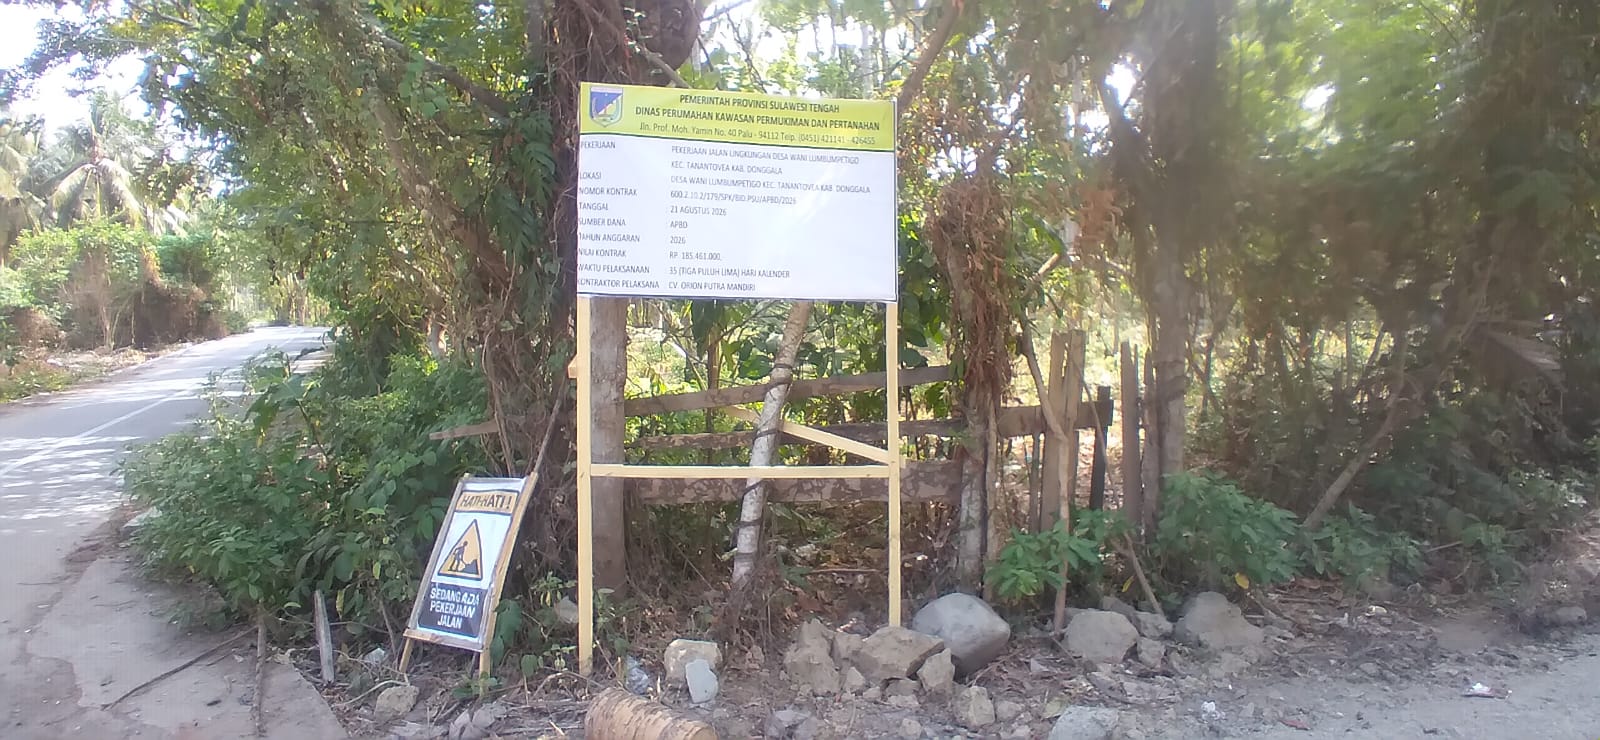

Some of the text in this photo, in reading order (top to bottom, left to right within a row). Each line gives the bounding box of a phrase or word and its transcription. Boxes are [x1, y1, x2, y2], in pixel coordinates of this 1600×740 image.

[680, 94, 840, 113] PEMERINTAH PROVINSI SULAWESI TENGAH
[636, 106, 880, 130] DINAS PERUMAHAN KAWASAN PERMUKIMAN DAN PERTANAHAN
[640, 122, 650, 130] Jln.
[653, 123, 668, 132] Prof.
[672, 124, 688, 134] Moh.
[692, 126, 712, 135] Yamin
[714, 128, 726, 136] No.
[728, 128, 736, 136] 40
[738, 129, 752, 138] Palu
[758, 130, 778, 140] 94112
[780, 132, 796, 142] Telp.
[798, 132, 820, 144] (0451)
[821, 134, 846, 143] 421141
[852, 136, 876, 144] 426455
[580, 140, 616, 149] PEKERJAAN
[672, 146, 706, 155] PEKERJAAN
[708, 148, 728, 156] JALAN
[730, 150, 771, 160] LINGKUNGAN
[772, 152, 788, 160] DESA
[687, 162, 730, 171] TANANTOVEA
[747, 166, 782, 174] DONGGALA
[580, 172, 602, 180] LOKASI
[671, 176, 688, 184] DESA
[689, 176, 707, 185] WANI
[836, 185, 870, 193] DONGGALA
[578, 187, 638, 196] NOMOR KONTRAK
[579, 202, 608, 210] TANGGAL
[670, 206, 727, 216] 21 AGUSTUS 2026
[578, 218, 606, 226] SUMBER
[670, 220, 688, 228] APBD
[579, 232, 640, 242] TAHUN ANGGARAN
[670, 236, 686, 244] 2026
[578, 248, 626, 256] NILAI KONTRAK
[602, 264, 650, 274] PELAKSANAAN
[670, 266, 790, 278] 35 (TIGA PULUH LIMA) HARI KALENDER
[622, 280, 660, 288] PELAKSANA
[680, 282, 702, 290] ORION
[704, 282, 725, 290] PUTRA
[726, 283, 756, 291] MANDIRI
[430, 588, 480, 606] SEDANG ADA
[430, 600, 476, 618] PEKERJAAN
[438, 614, 462, 629] JALAN
